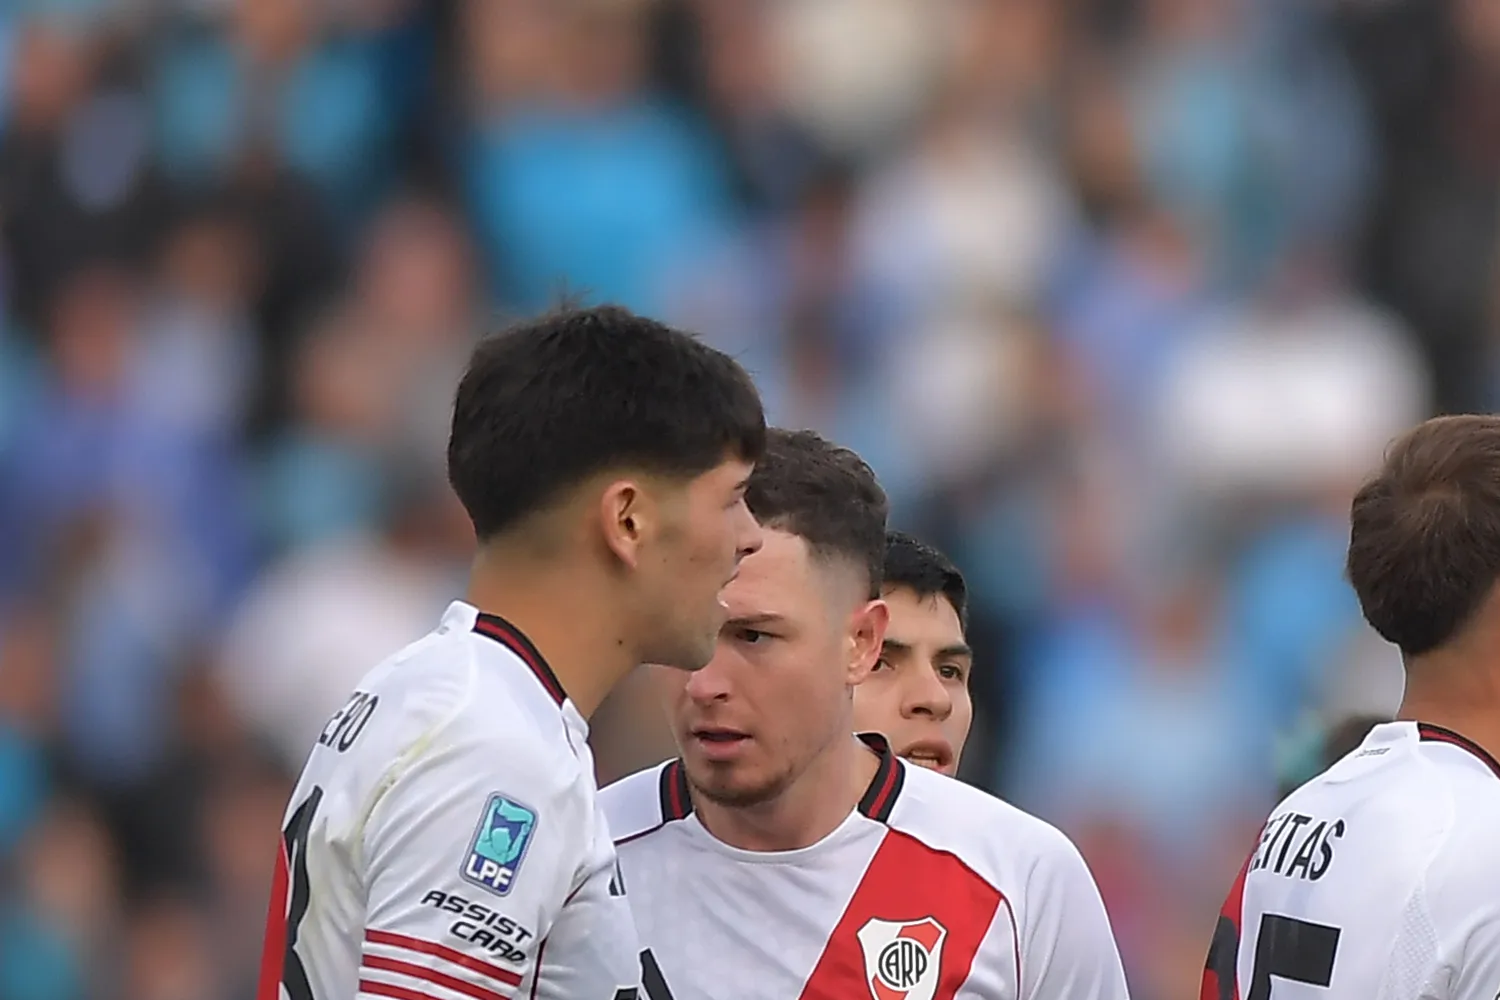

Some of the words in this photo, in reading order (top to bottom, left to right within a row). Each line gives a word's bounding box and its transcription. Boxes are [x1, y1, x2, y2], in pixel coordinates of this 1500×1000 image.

[465, 854, 513, 889] LPF
[421, 890, 532, 943] ASSIST
[451, 921, 526, 963] CARD
